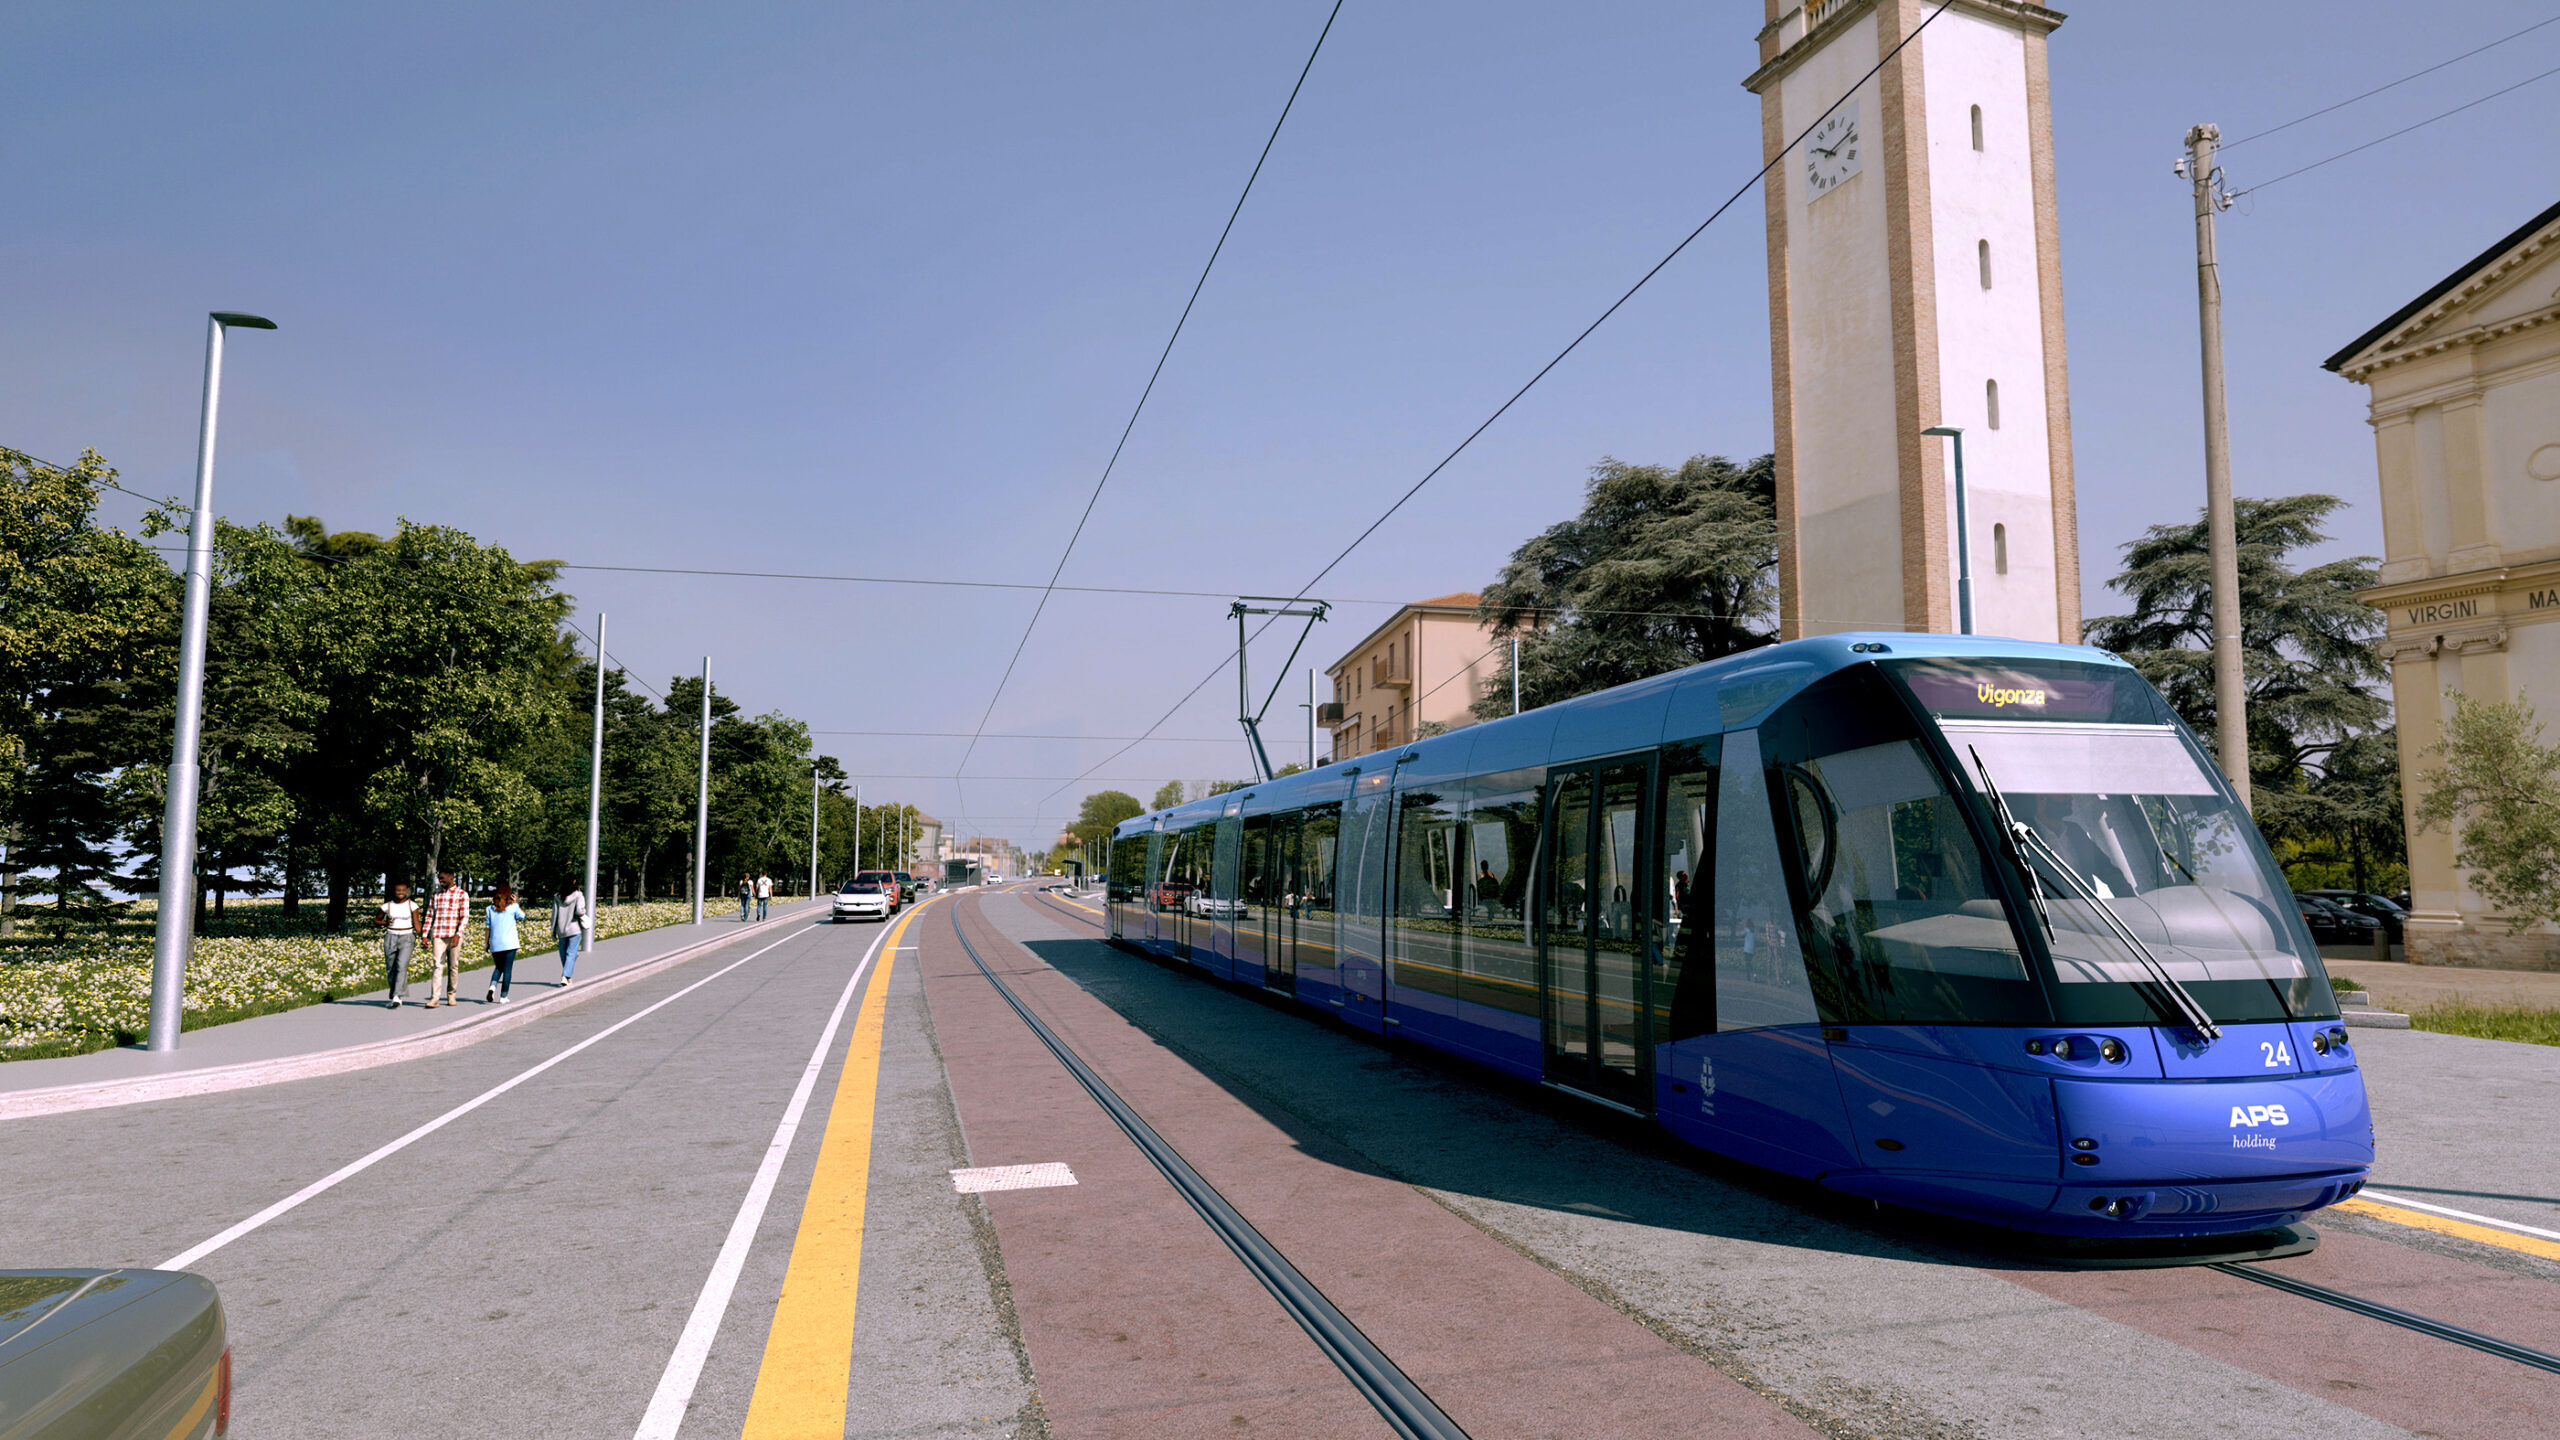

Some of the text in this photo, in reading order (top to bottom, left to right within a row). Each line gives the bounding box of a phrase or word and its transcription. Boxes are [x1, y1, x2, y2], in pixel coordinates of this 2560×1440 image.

[2408, 599, 2478, 624] VIRGINI
[1977, 683, 2046, 708] Vigonza
[2260, 1041, 2291, 1068] 24
[2229, 1104, 2290, 1128] APS
[2232, 1134, 2277, 1150] holding
